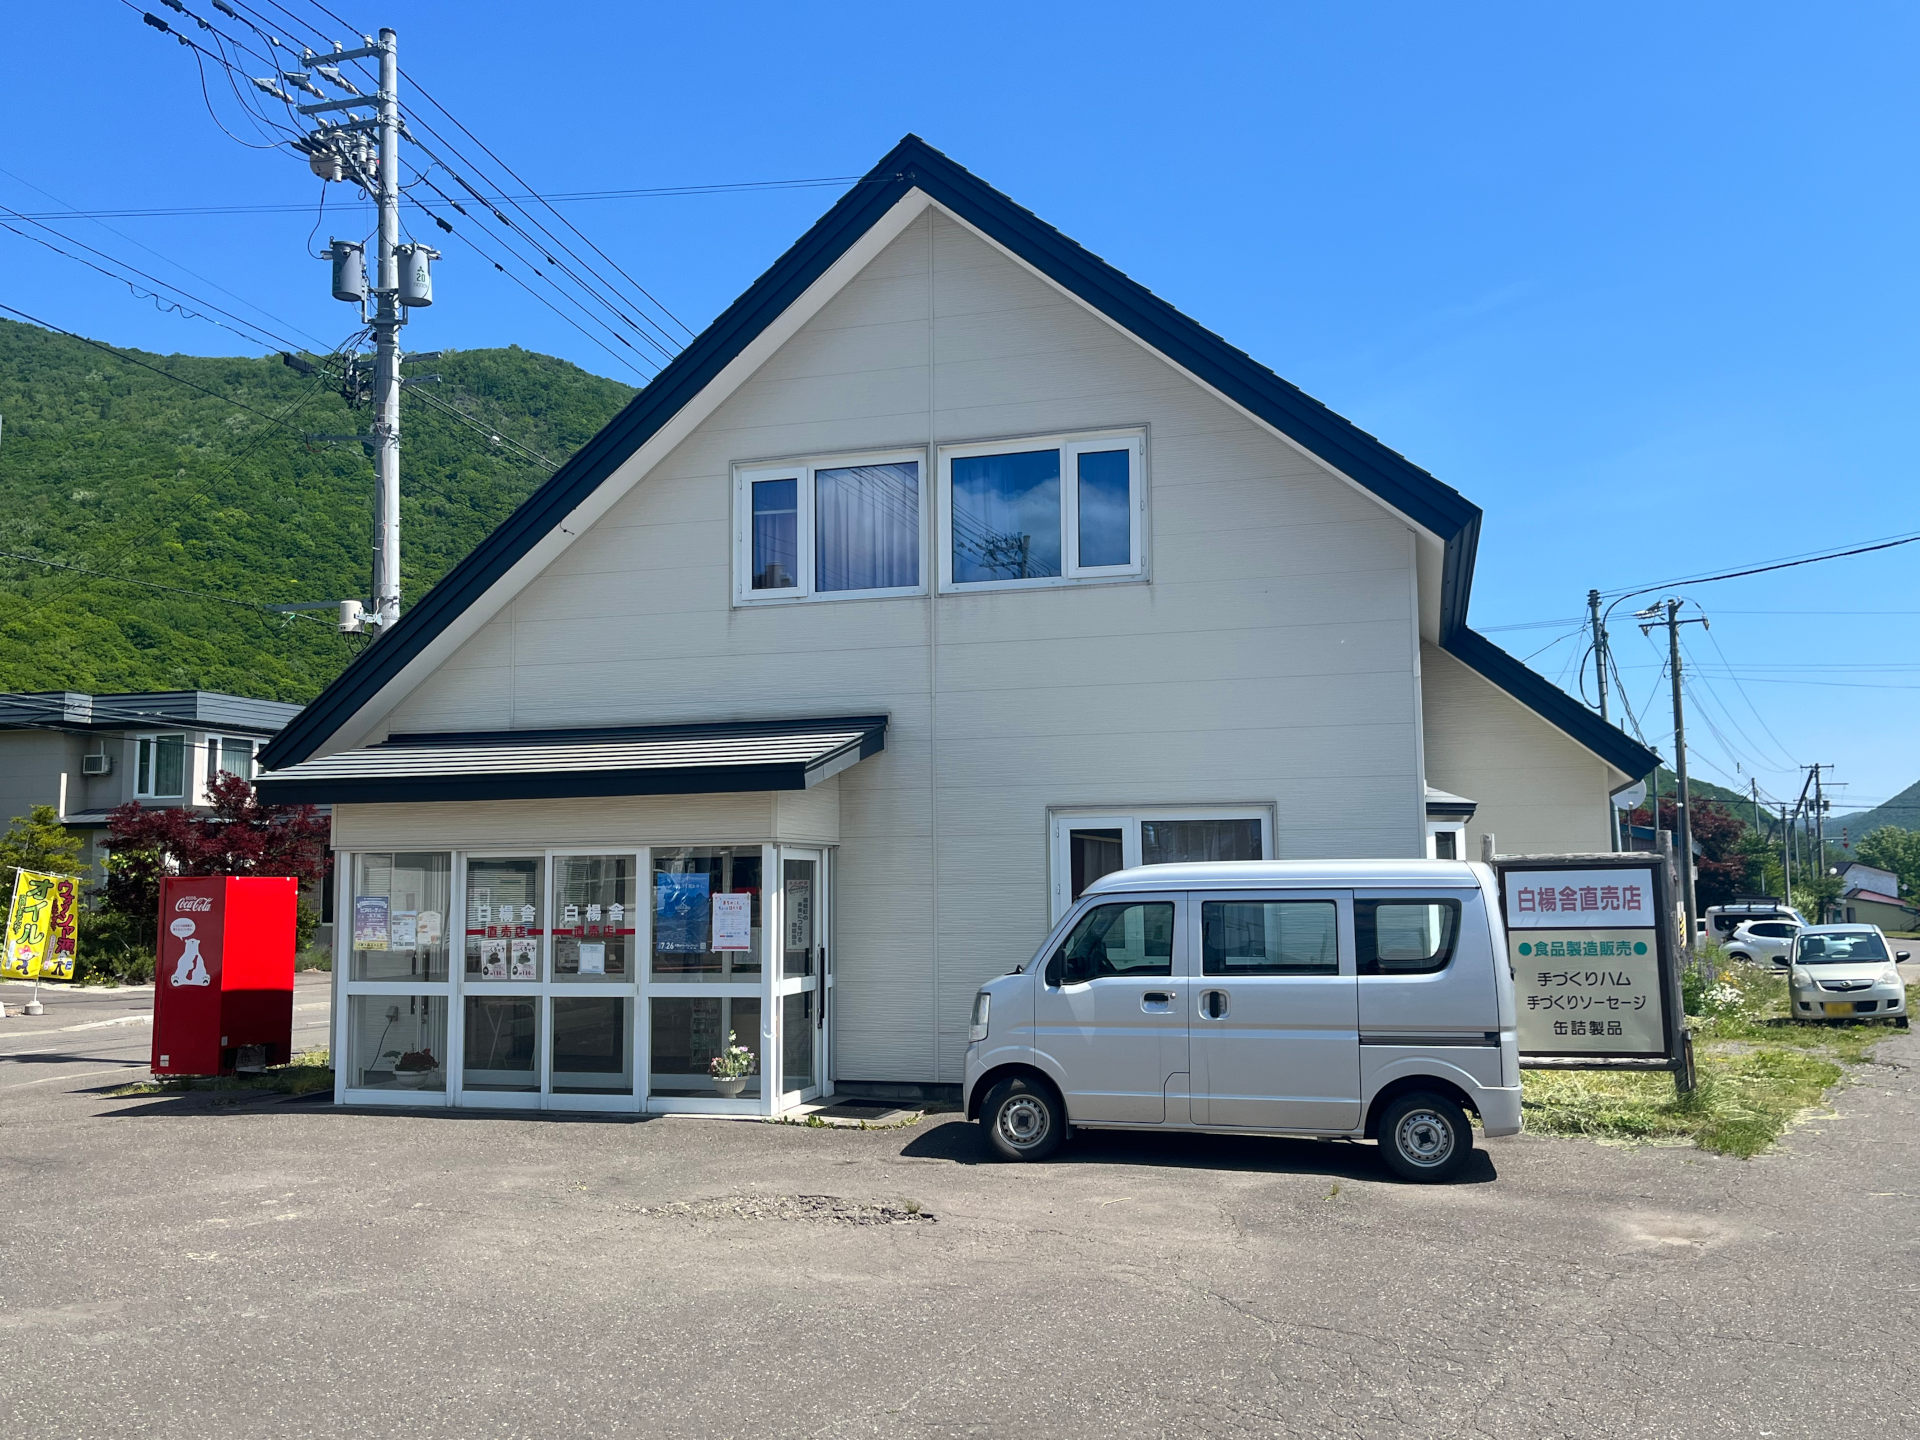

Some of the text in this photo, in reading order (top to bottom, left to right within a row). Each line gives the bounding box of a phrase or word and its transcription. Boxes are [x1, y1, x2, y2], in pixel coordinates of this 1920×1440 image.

[175, 896, 214, 912] Coca-Cola
[1517, 885, 1642, 913] 白楊舎直売店
[16, 879, 55, 945] オイル
[55, 879, 76, 955] ウォッシャー液
[478, 904, 536, 922] 白楊舎
[564, 902, 624, 922] 白楊舎
[488, 925, 526, 938] 直売店
[574, 925, 614, 938] 直売店
[1533, 940, 1632, 958] 食品製造販売
[1537, 971, 1632, 988] 手づくりハム
[1527, 995, 1647, 1010] 手づくりソーセージ
[1553, 1020, 1623, 1036] 缶詰製品
